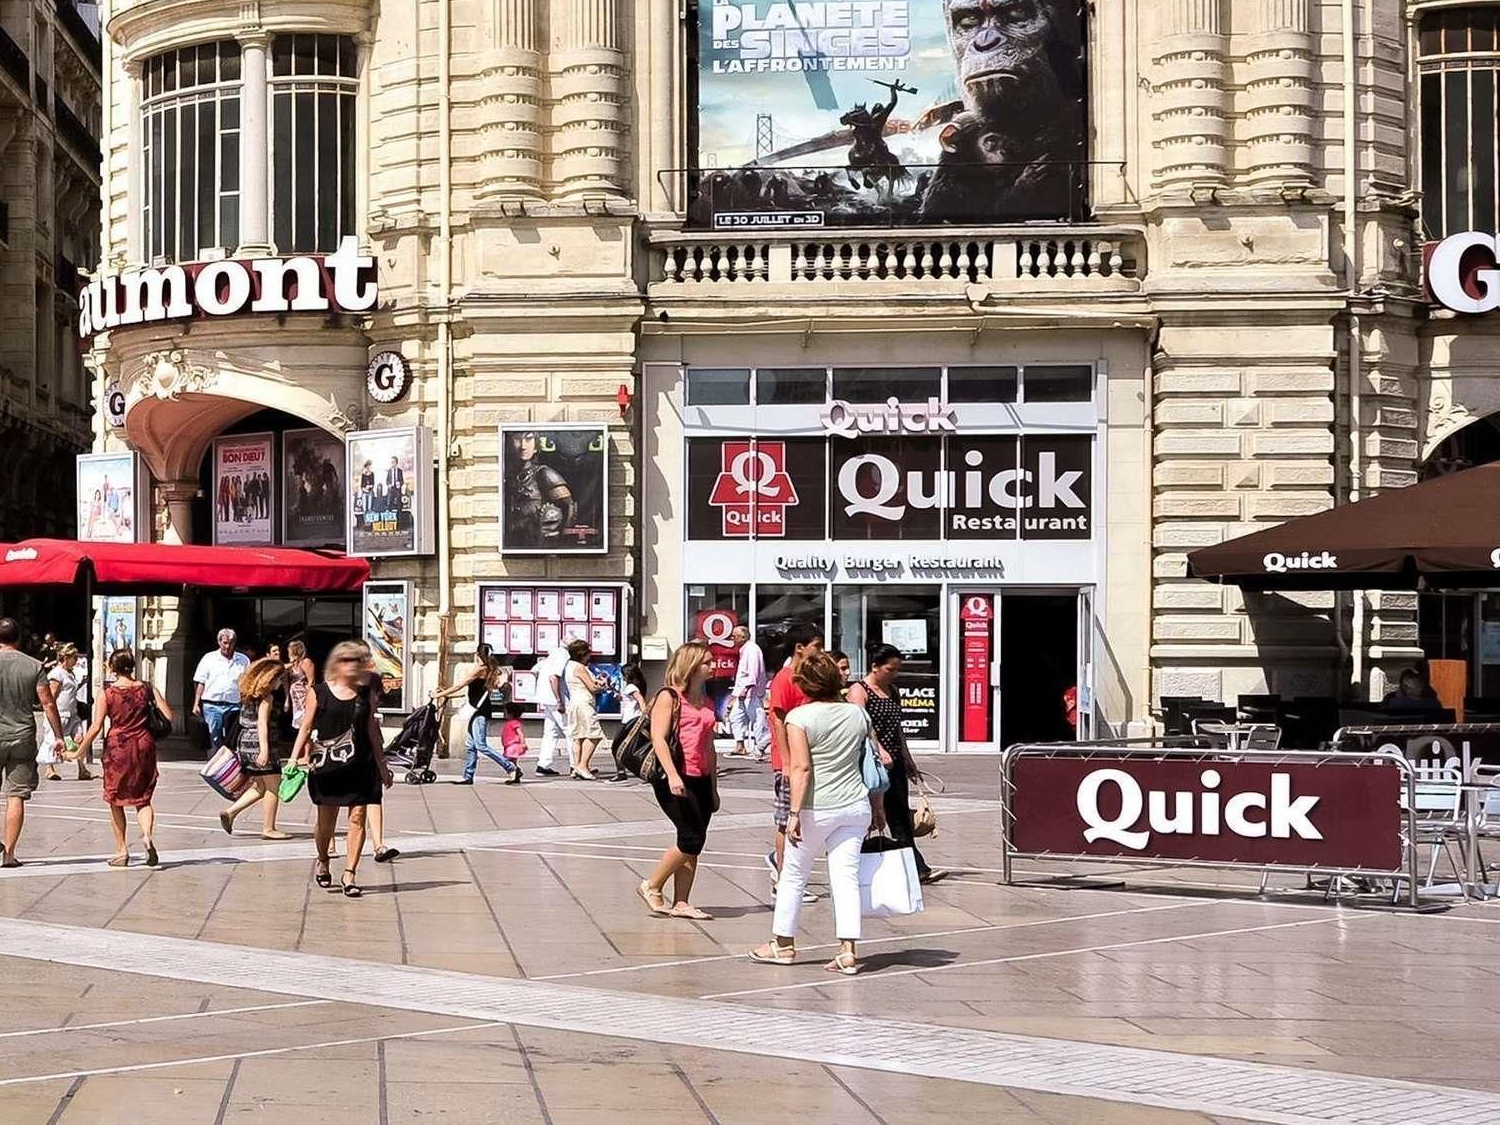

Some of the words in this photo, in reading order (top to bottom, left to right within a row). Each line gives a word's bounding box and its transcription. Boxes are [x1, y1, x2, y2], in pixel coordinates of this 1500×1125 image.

[713, 40, 739, 49] DES
[740, 28, 911, 59] SINGES
[713, 56, 910, 74] L'AFFRONTEMENT
[750, 215, 791, 224] JUILLET
[820, 396, 958, 439] Quick
[838, 450, 1087, 521] Quick
[726, 510, 781, 525] Quick
[952, 515, 1088, 530] Restaurant
[775, 554, 836, 571] Quality
[844, 555, 902, 571] Burger
[909, 554, 1003, 569] Restaurant
[1263, 551, 1337, 572] Quick
[899, 688, 935, 697] PLACE
[900, 697, 935, 707] INÉMA
[1076, 768, 1324, 850] Quick
